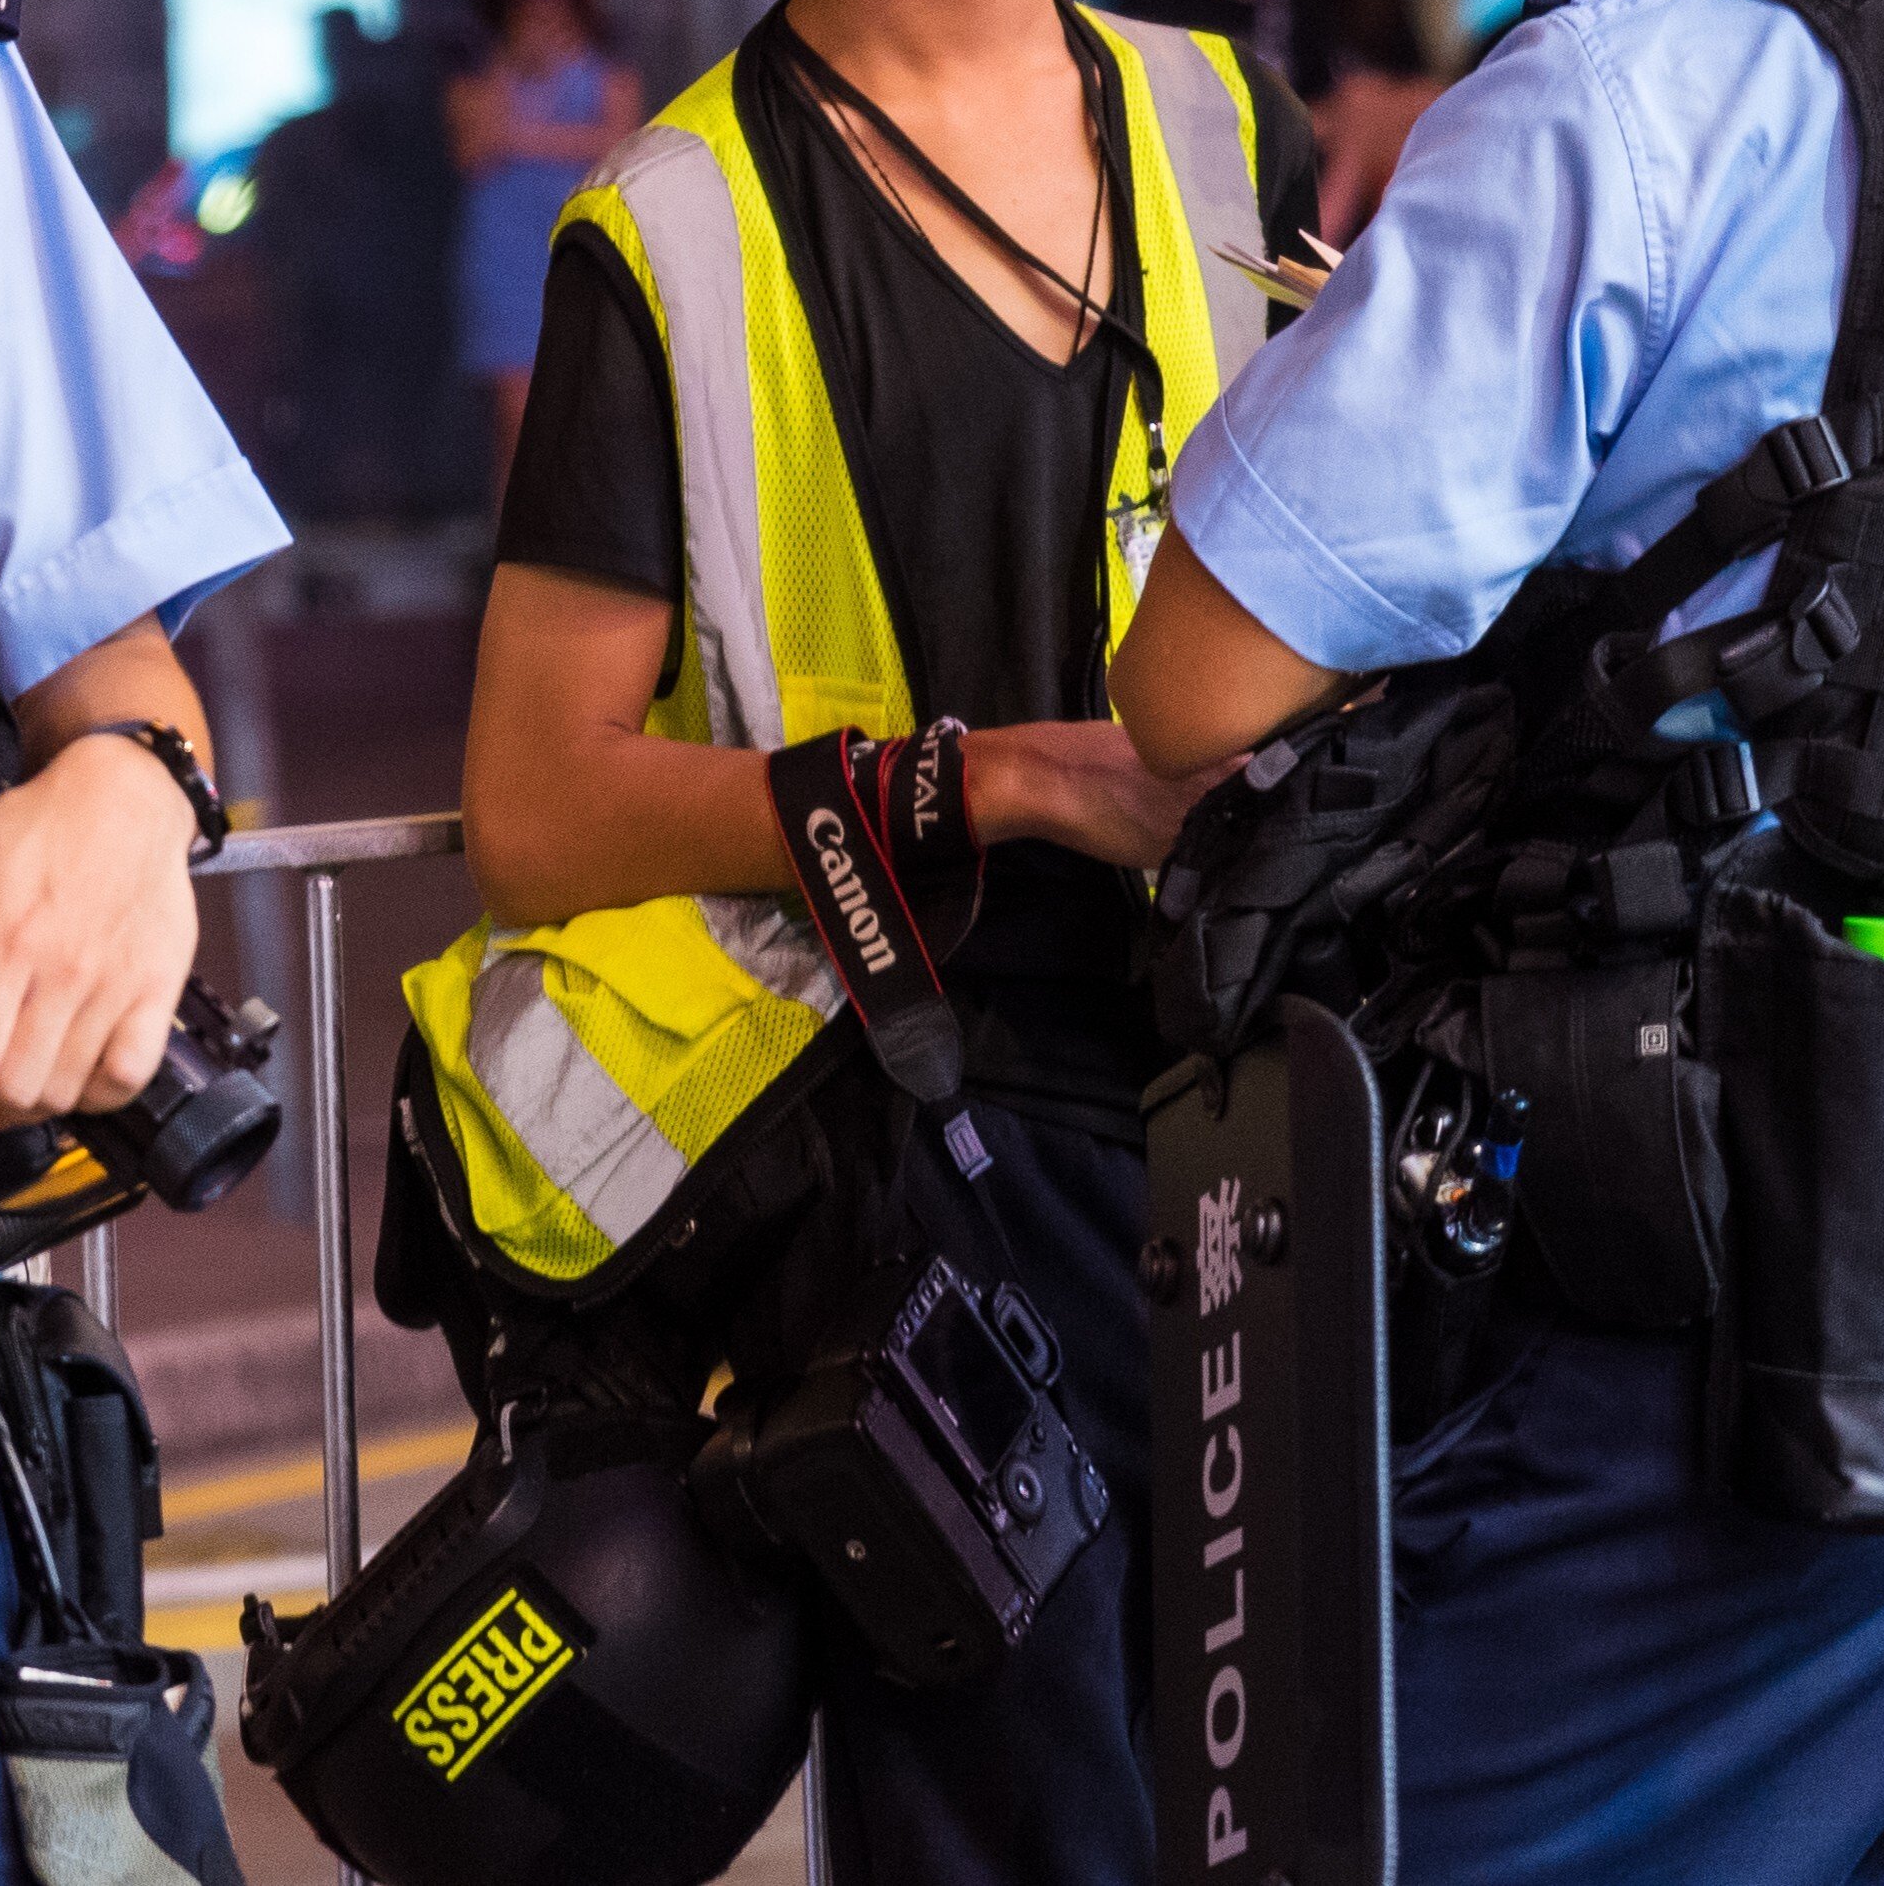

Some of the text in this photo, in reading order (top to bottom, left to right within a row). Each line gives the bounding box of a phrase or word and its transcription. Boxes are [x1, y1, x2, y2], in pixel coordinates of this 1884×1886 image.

[806, 807, 898, 975] Canon
[404, 1598, 563, 1767] PRESS
[1203, 1329, 1248, 1868] POLICE
